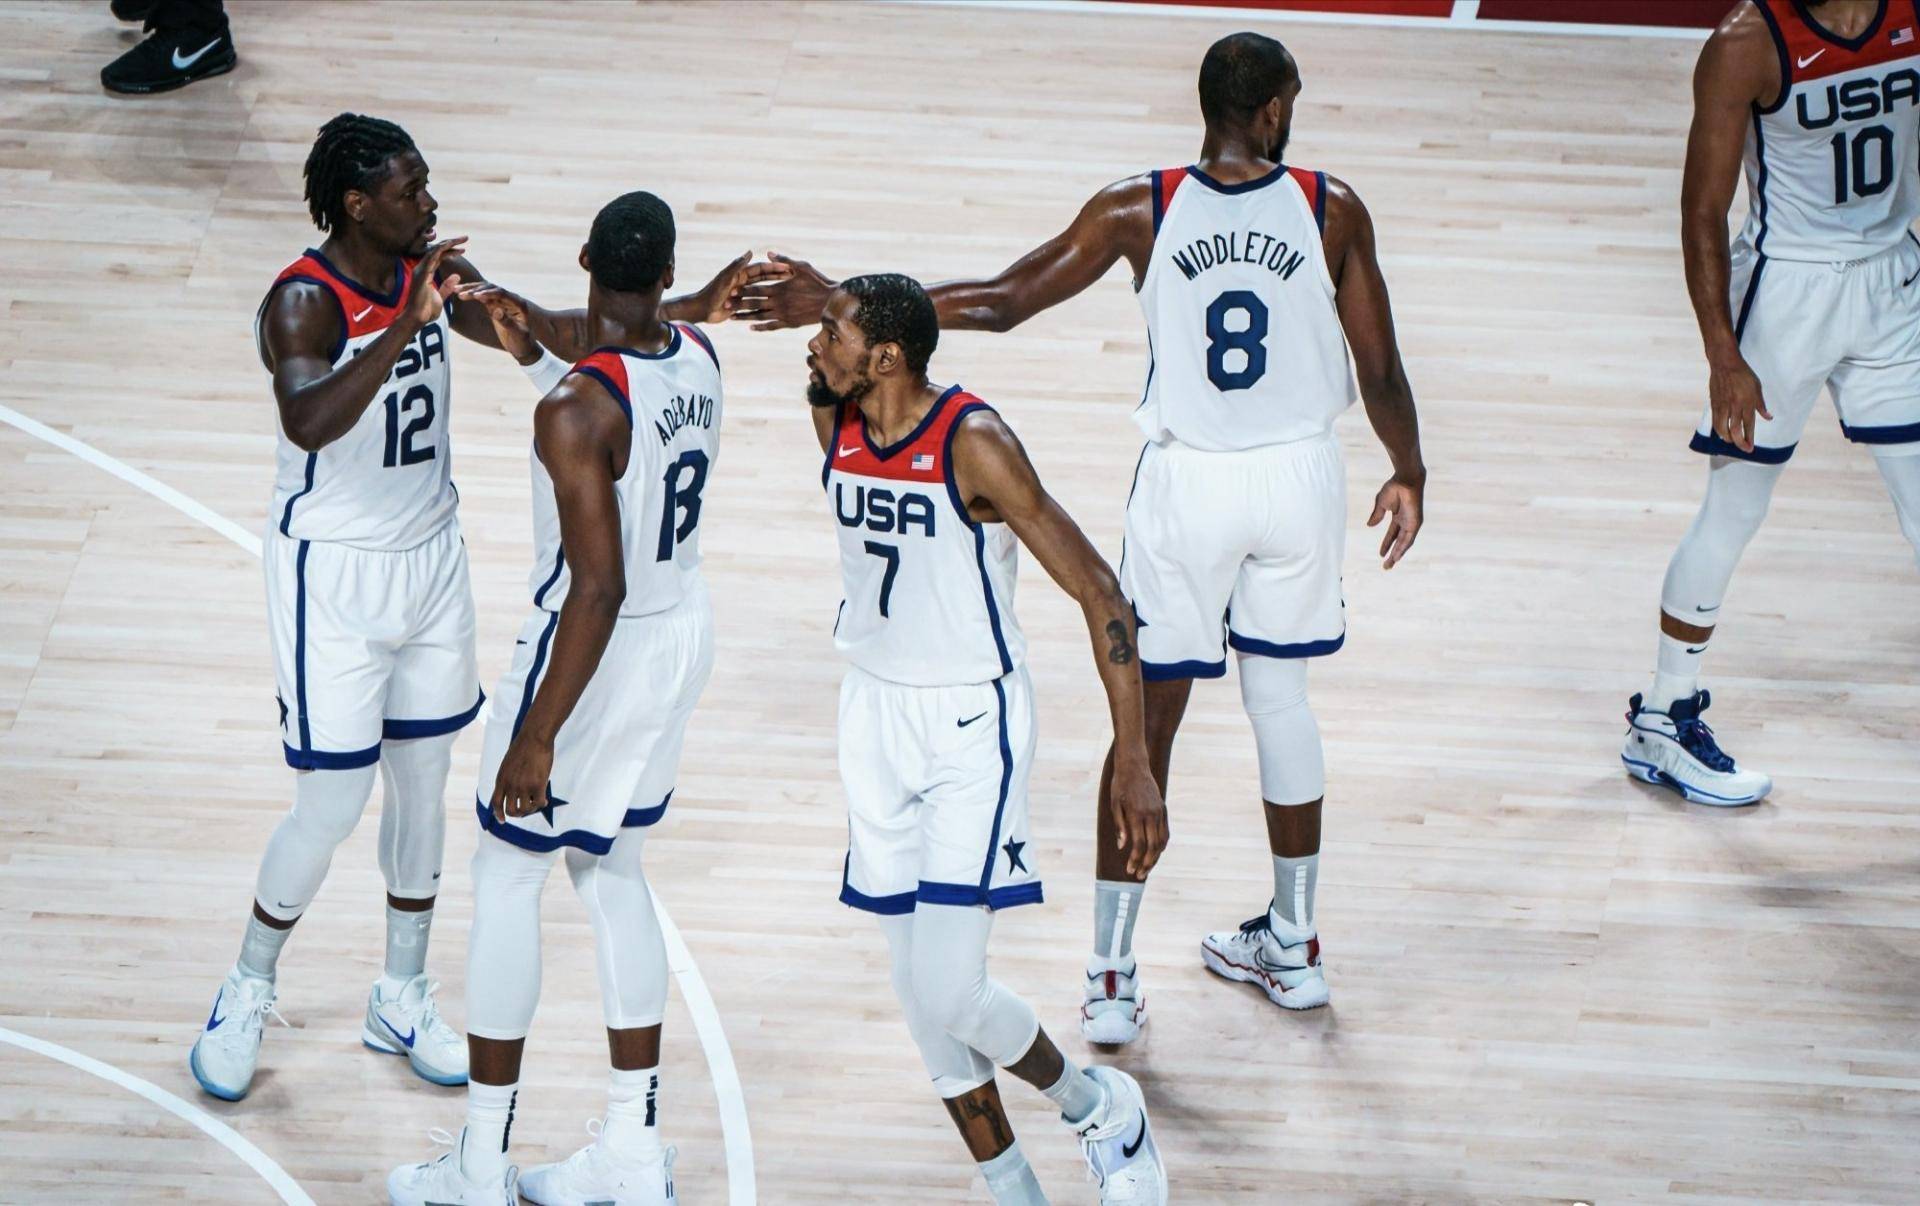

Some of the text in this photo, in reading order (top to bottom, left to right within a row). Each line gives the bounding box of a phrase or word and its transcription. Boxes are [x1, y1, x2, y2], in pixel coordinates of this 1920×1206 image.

[1796, 68, 1920, 130] USA
[1831, 125, 1894, 204] 10
[1172, 231, 1305, 281] MIDDLETON
[353, 322, 444, 384] SA
[1206, 290, 1268, 392] 8
[383, 384, 435, 468] 12
[655, 394, 713, 447] ADEBAYO
[656, 448, 709, 562] 13
[836, 482, 935, 537] USA
[864, 540, 900, 619] 7
